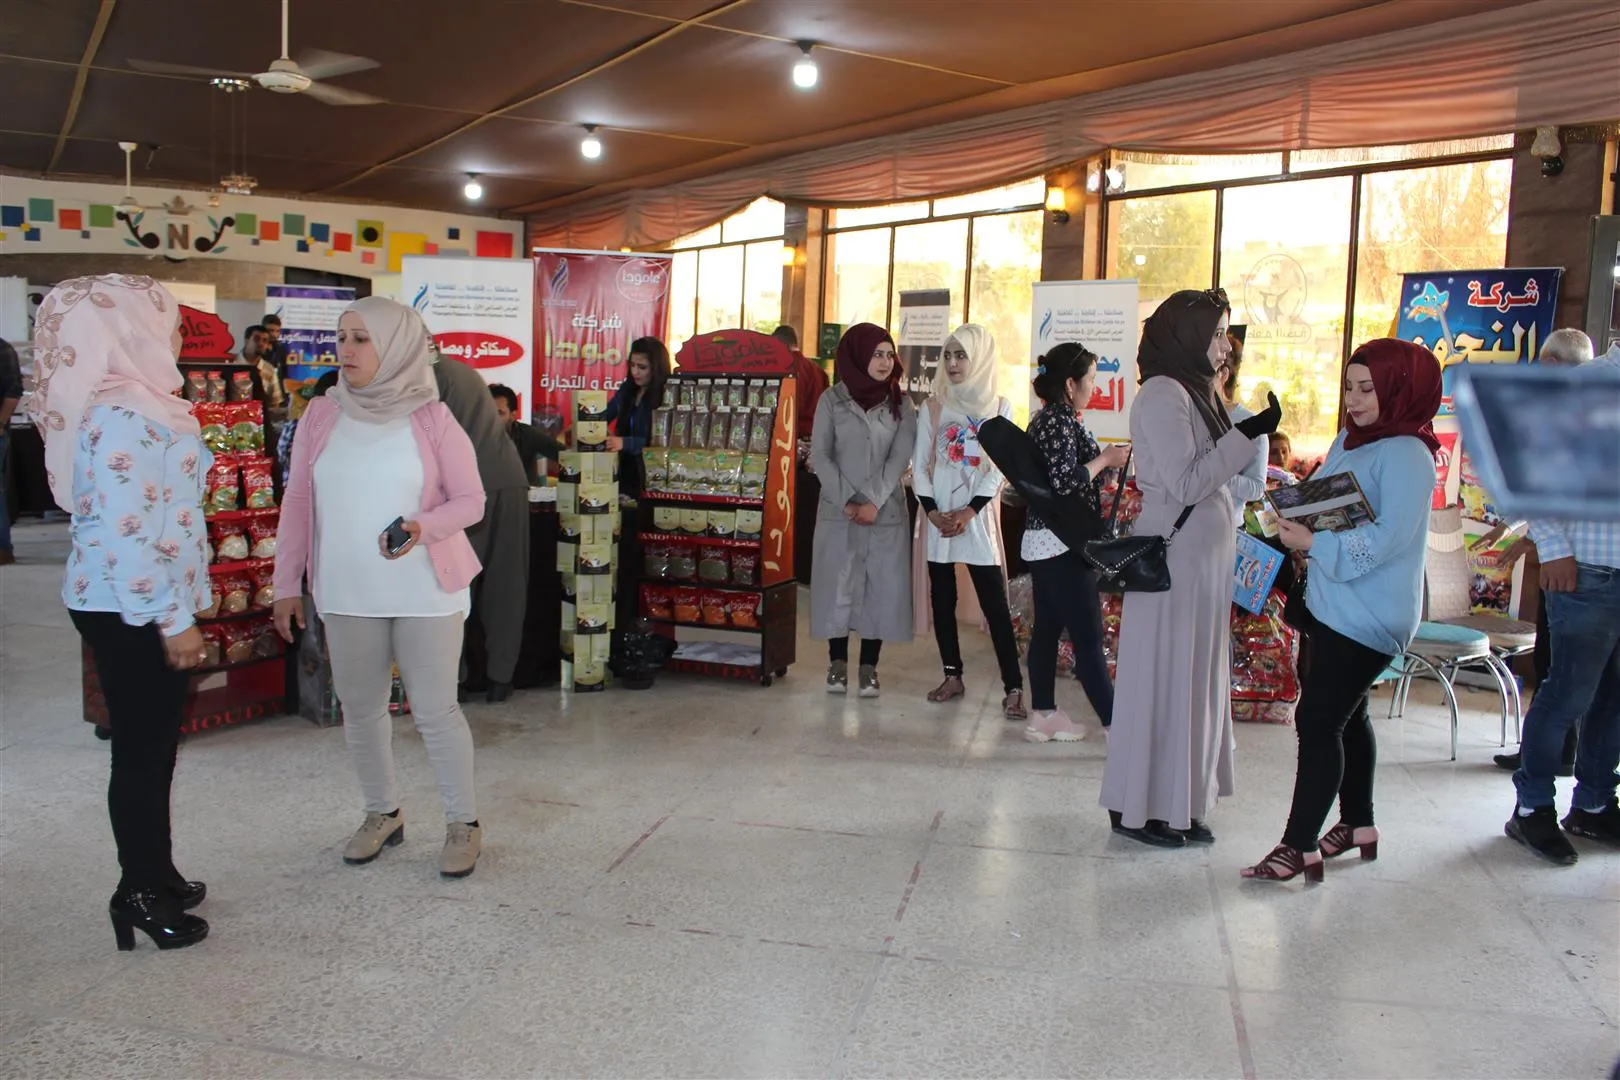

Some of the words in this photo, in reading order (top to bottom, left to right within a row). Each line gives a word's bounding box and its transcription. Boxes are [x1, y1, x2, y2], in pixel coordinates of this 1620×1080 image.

[168, 223, 189, 249] N
[1467, 278, 1540, 313] شركة
[572, 312, 622, 333] شركة
[440, 340, 473, 358] ومصا
[473, 341, 510, 358] سكاكر
[545, 329, 633, 366] امودا
[540, 373, 586, 392] التجارة
[1085, 376, 1125, 413] الع
[644, 491, 693, 502] AMOUDA
